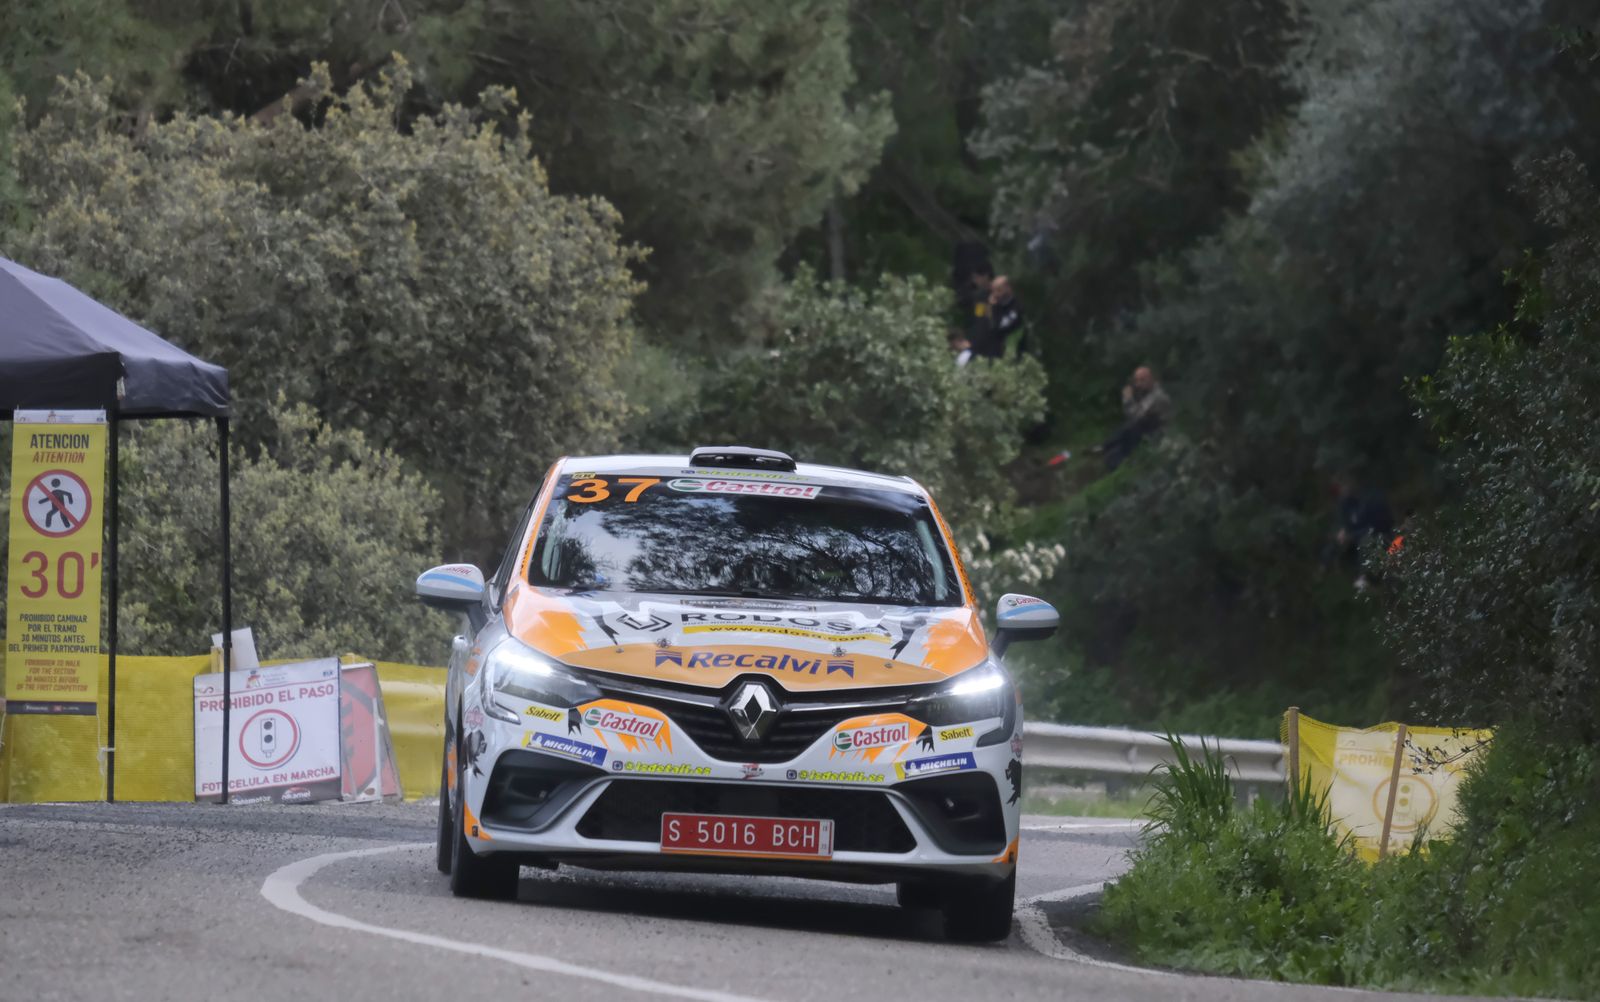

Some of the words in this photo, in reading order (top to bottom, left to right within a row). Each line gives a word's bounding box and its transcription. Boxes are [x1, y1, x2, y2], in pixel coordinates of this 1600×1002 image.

[30, 434, 90, 449] ATENCION
[32, 451, 85, 463] ATTENTION
[567, 478, 661, 503] 37
[705, 480, 814, 498] Castrol
[20, 550, 99, 599] 30'
[19, 613, 55, 622] PROHIBIDO
[57, 614, 88, 623] CAMINAR
[27, 623, 41, 632] POR
[43, 624, 51, 632] EL
[53, 624, 77, 633] TRAMO
[709, 625, 866, 642] www.rodosa.com
[21, 634, 30, 642] 30
[32, 634, 61, 642] MINUTOS
[63, 635, 85, 643] ANTES
[8, 643, 20, 652] DEL
[23, 644, 48, 652] PRIMER
[50, 644, 98, 653] PARTICIPANTE
[687, 651, 822, 675] Recalvi
[278, 689, 296, 703] EL
[298, 684, 334, 699] PASO
[600, 712, 660, 737] Castrol
[853, 726, 907, 746] Castrol
[543, 739, 597, 758] MICHELIN
[919, 757, 969, 771] MICHELIN
[201, 775, 270, 792] FOTCELULA
[272, 773, 288, 783] EN
[290, 766, 336, 780] MARCHA
[668, 819, 681, 842] S
[697, 820, 757, 846] 5016
[771, 823, 816, 848] BCH
